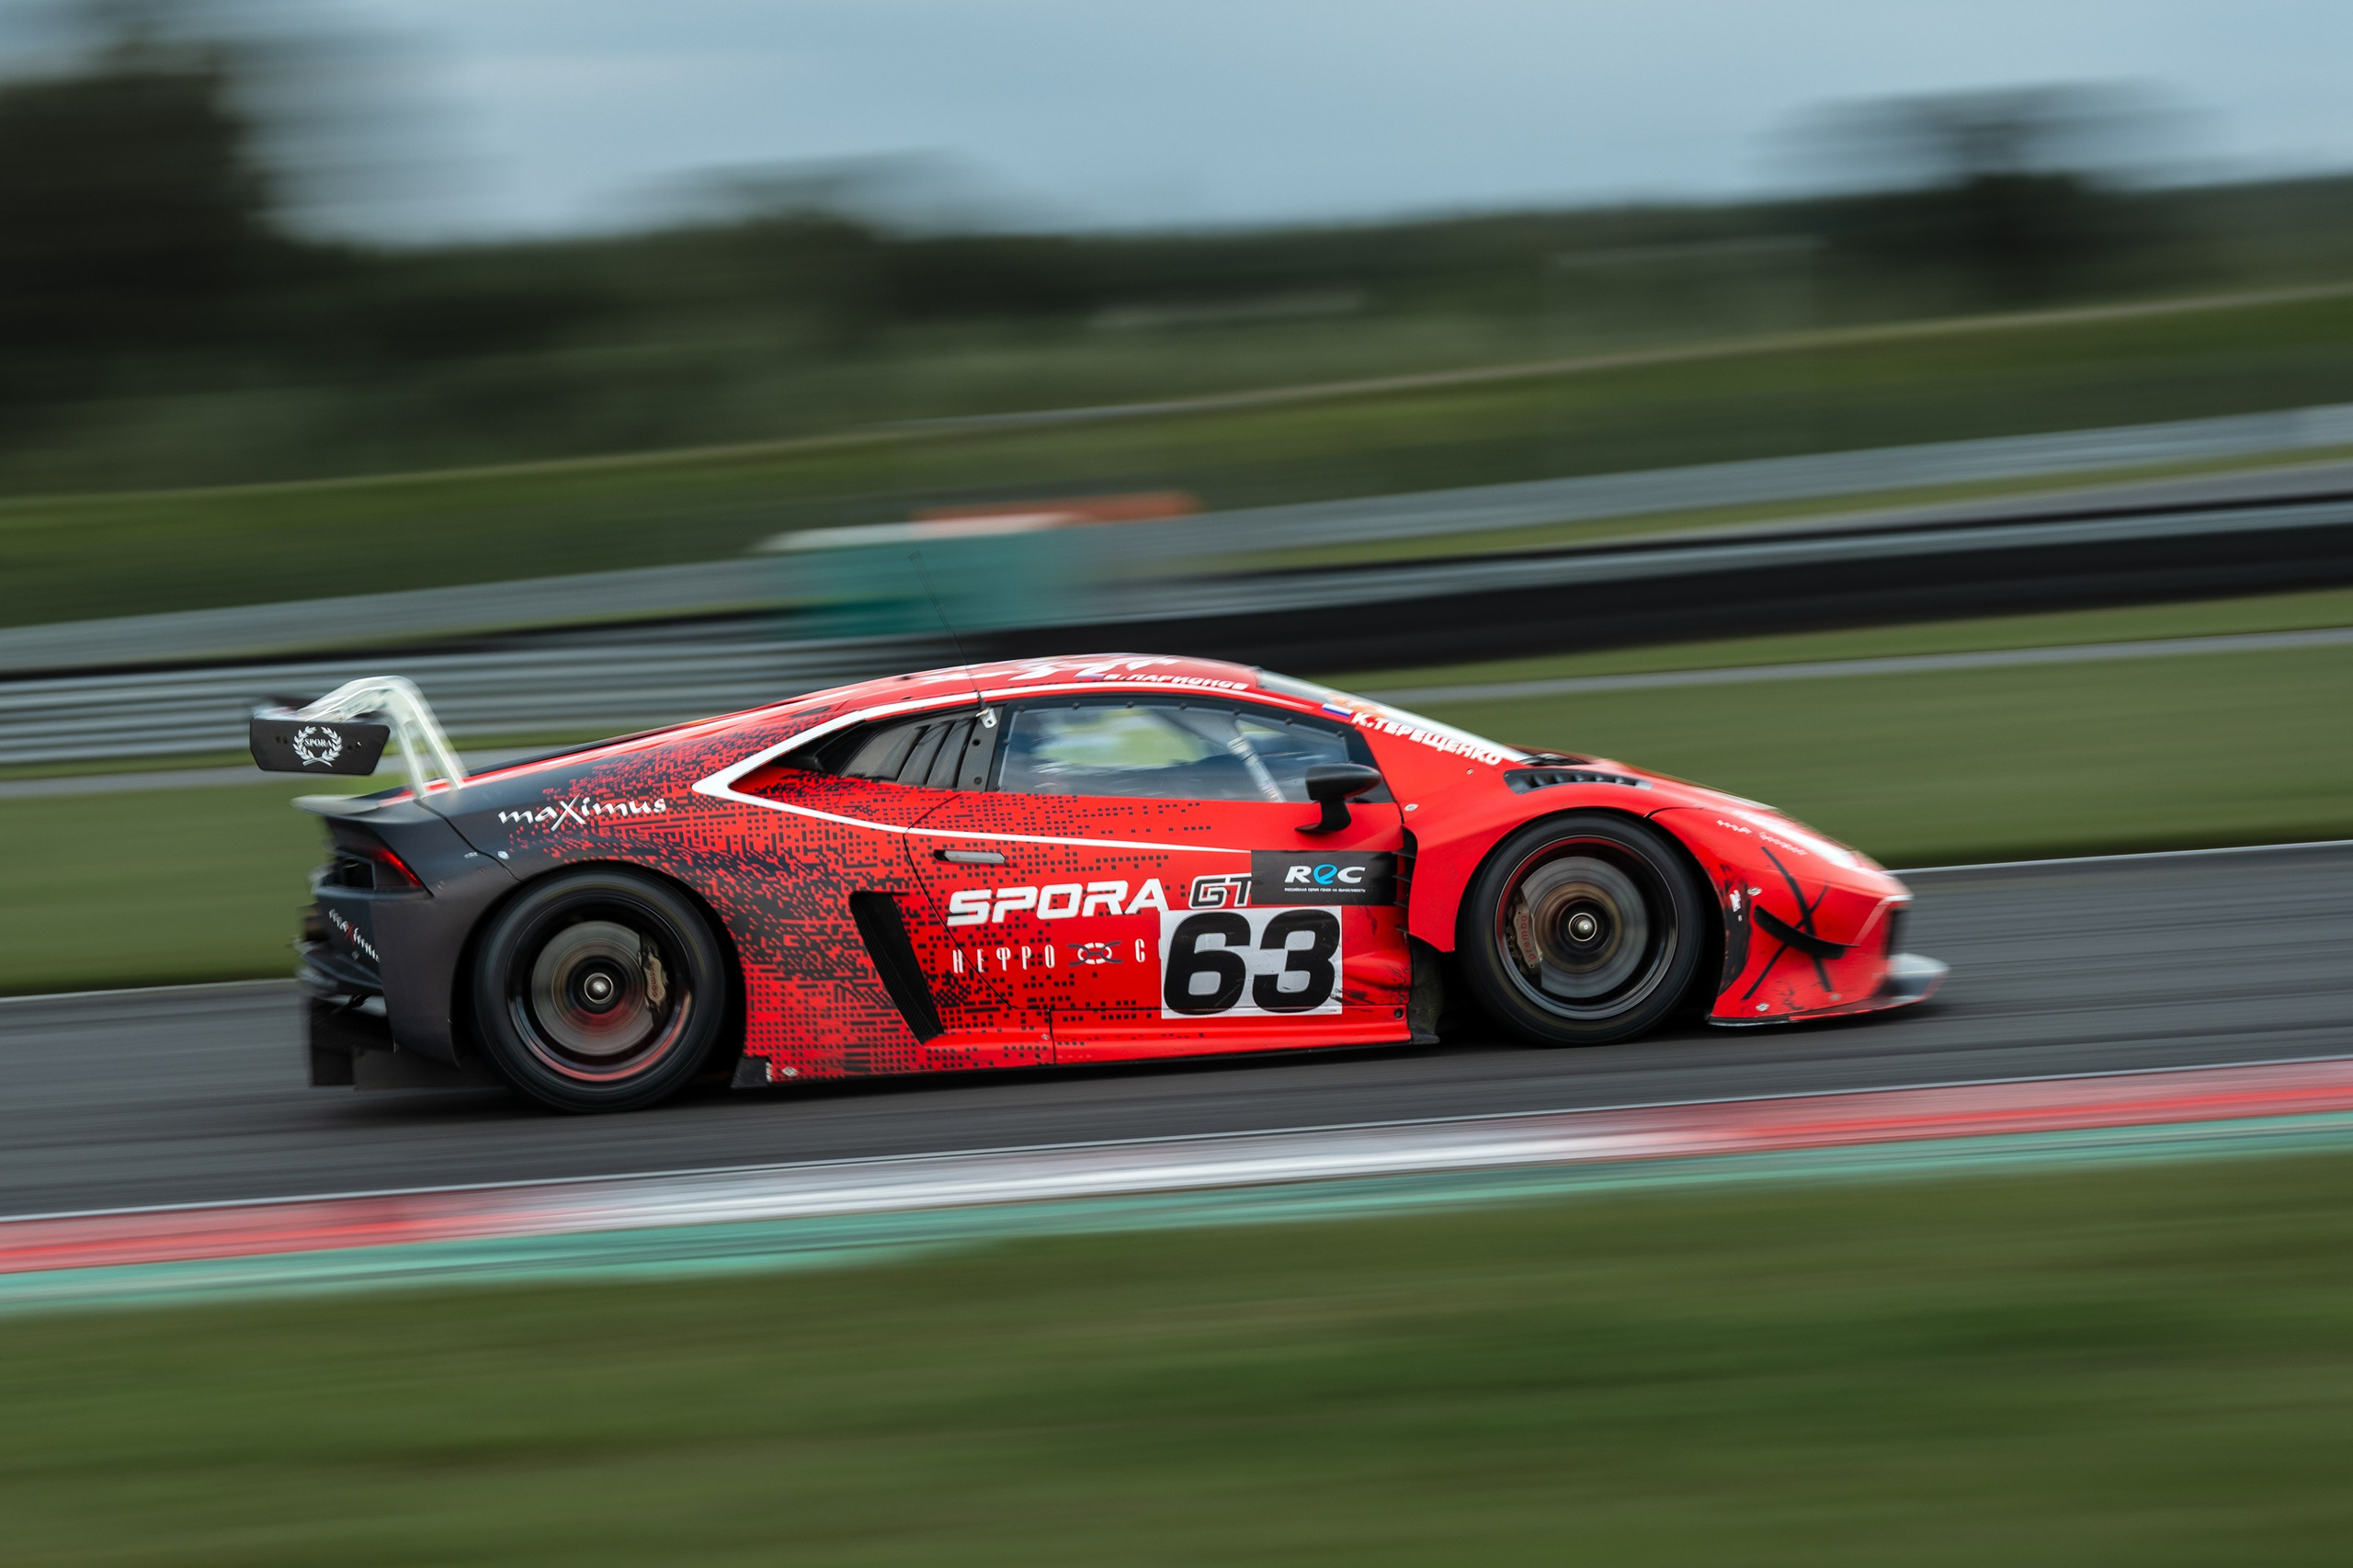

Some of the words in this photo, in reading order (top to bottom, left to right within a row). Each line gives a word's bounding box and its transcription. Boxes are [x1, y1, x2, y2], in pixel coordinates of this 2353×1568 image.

[304, 738, 334, 747] SPORA
[1351, 711, 1503, 766] К.ТЕРЕЩЕНКО
[947, 879, 1168, 926] SPORA
[952, 944, 1055, 973] НЕФРО
[1164, 909, 1340, 1016] 63
